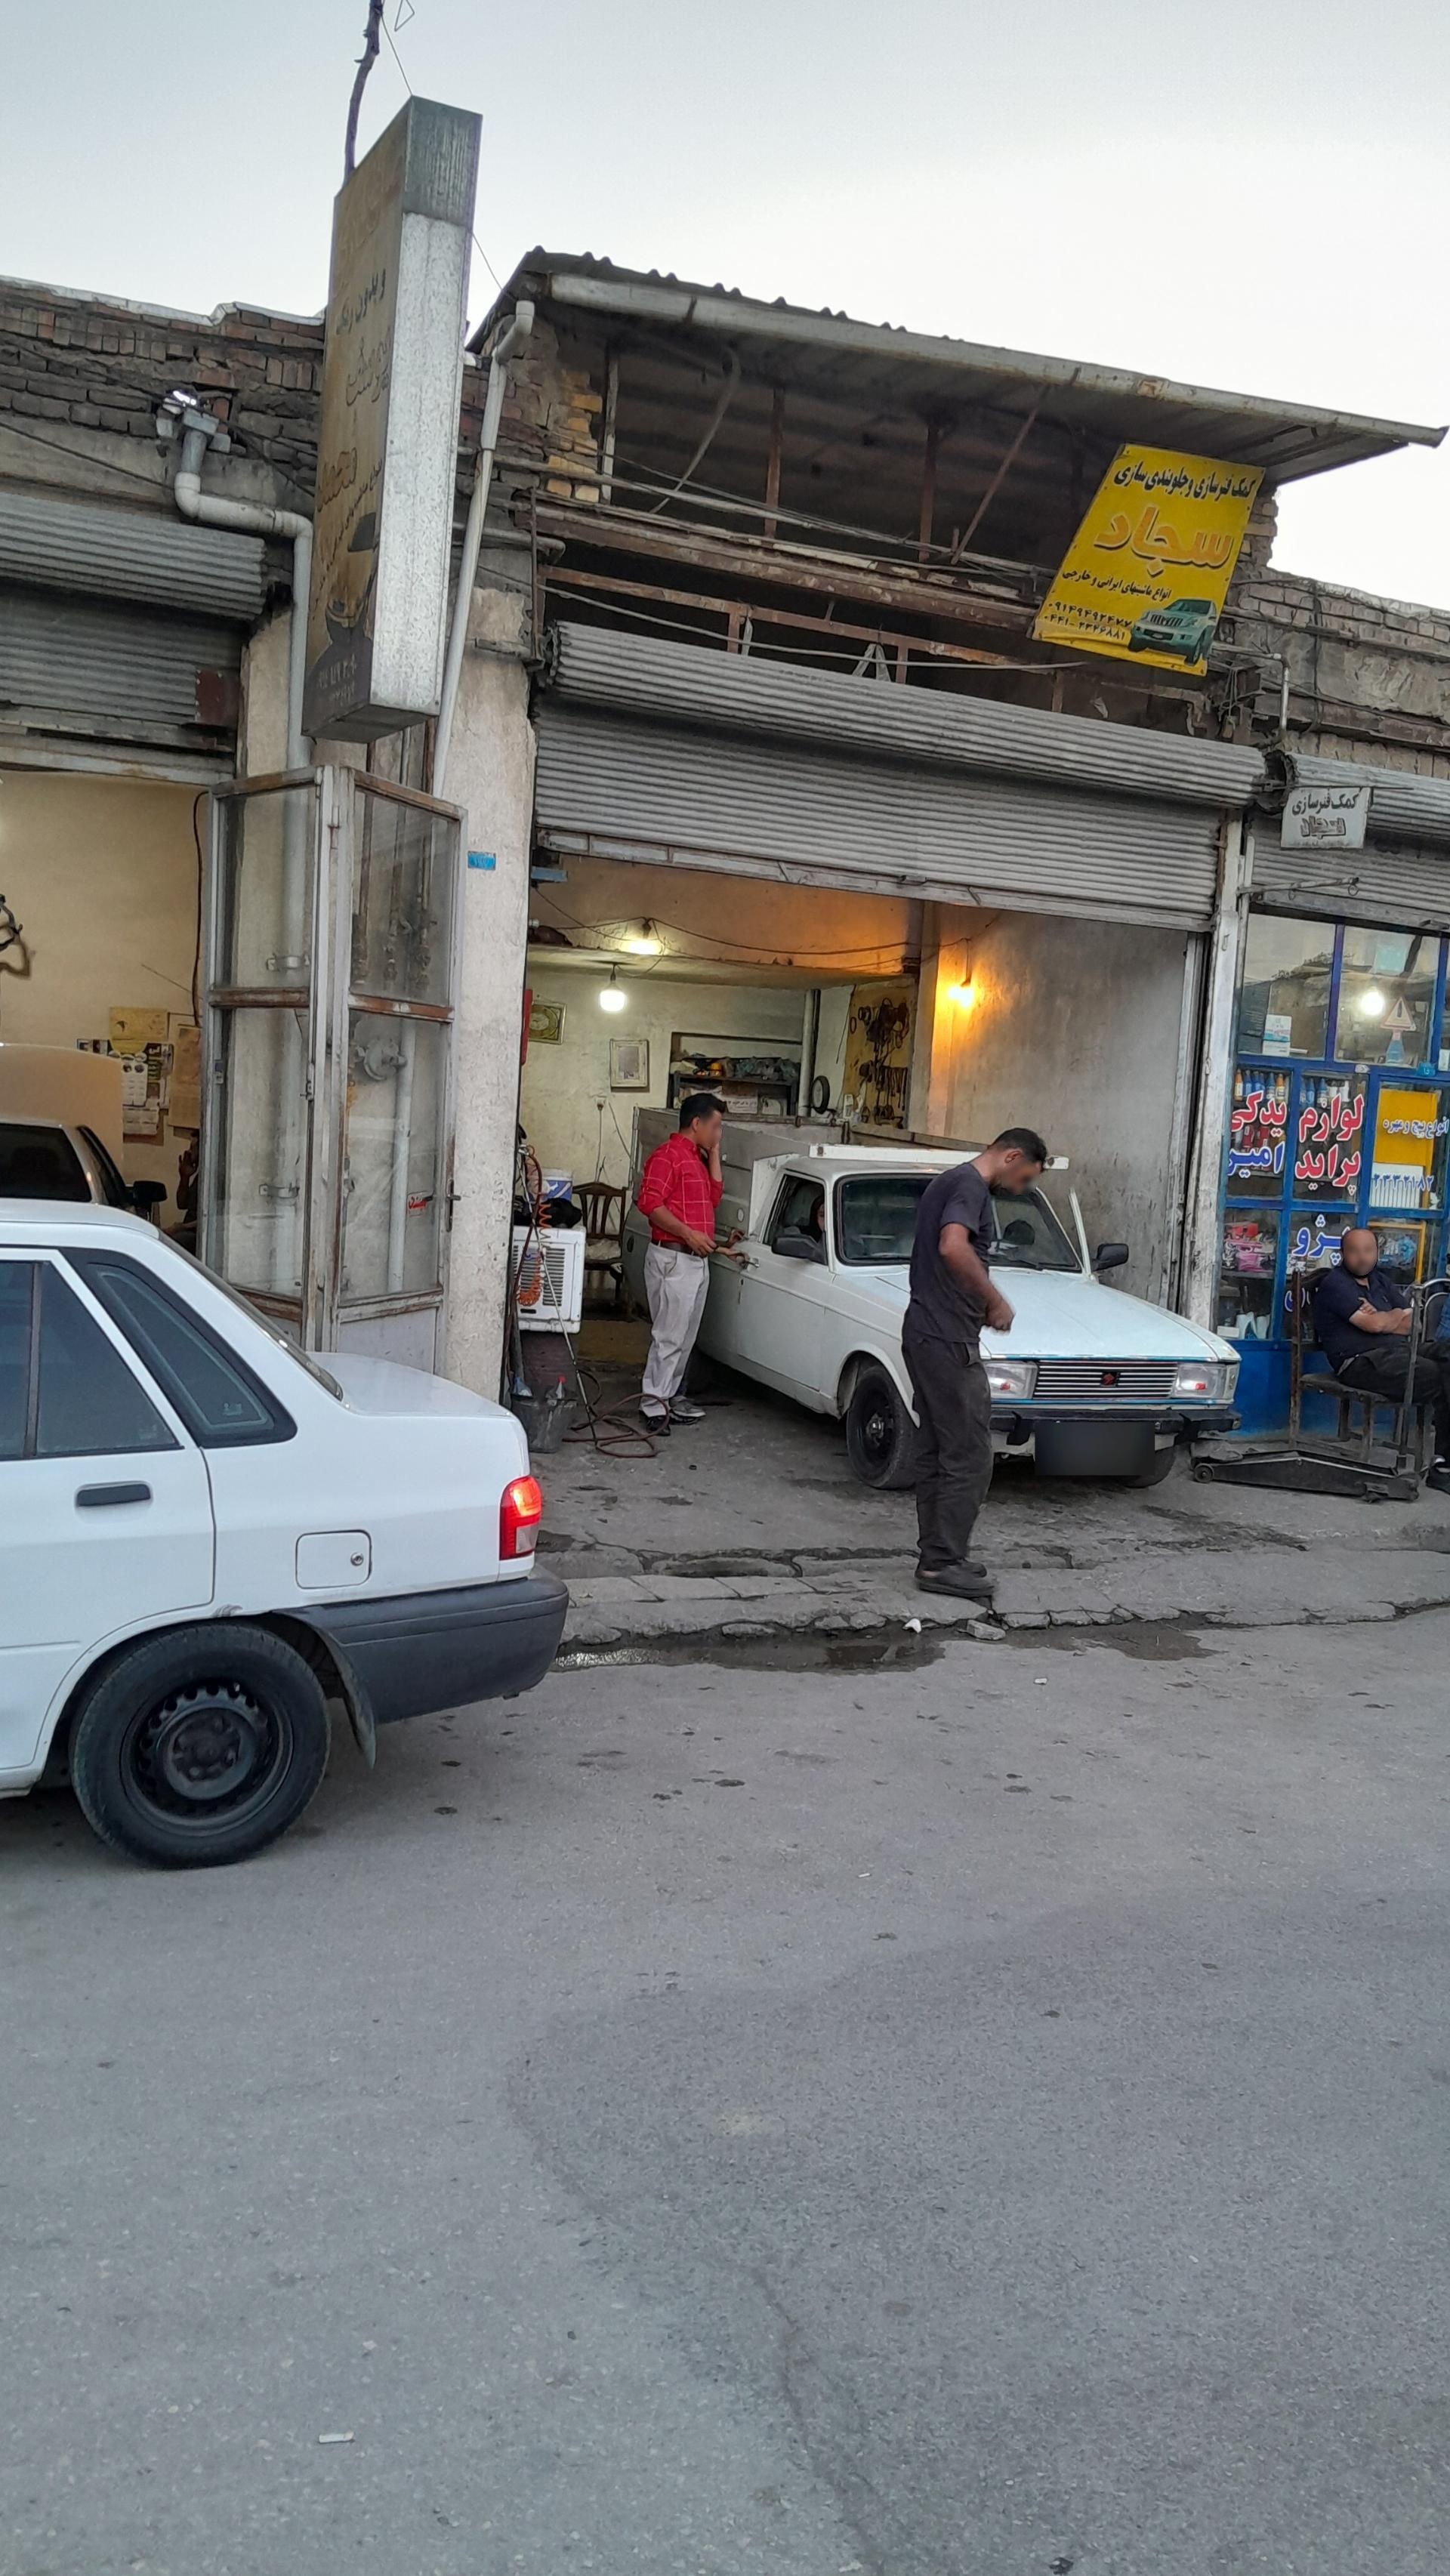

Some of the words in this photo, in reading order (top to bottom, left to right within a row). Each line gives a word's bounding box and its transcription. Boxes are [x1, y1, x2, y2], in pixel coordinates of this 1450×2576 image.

[1232, 477, 1257, 498] کمک
[1094, 506, 1235, 578] سجاد
[1062, 569, 1091, 582] خارجی
[1091, 577, 1097, 586] و
[1097, 576, 1123, 591] ایرانی
[1152, 588, 1172, 602] انواع
[1331, 793, 1360, 810] کمک
[1231, 1090, 1288, 1137] یدکی
[1299, 1093, 1365, 1143] لوازم
[1382, 1118, 1404, 1134] مهره
[1402, 1120, 1410, 1134] و
[1410, 1119, 1426, 1139] پیچ
[1425, 1115, 1450, 1140] انواع
[1227, 1141, 1285, 1179] امیر
[1294, 1143, 1362, 1196] پراید
